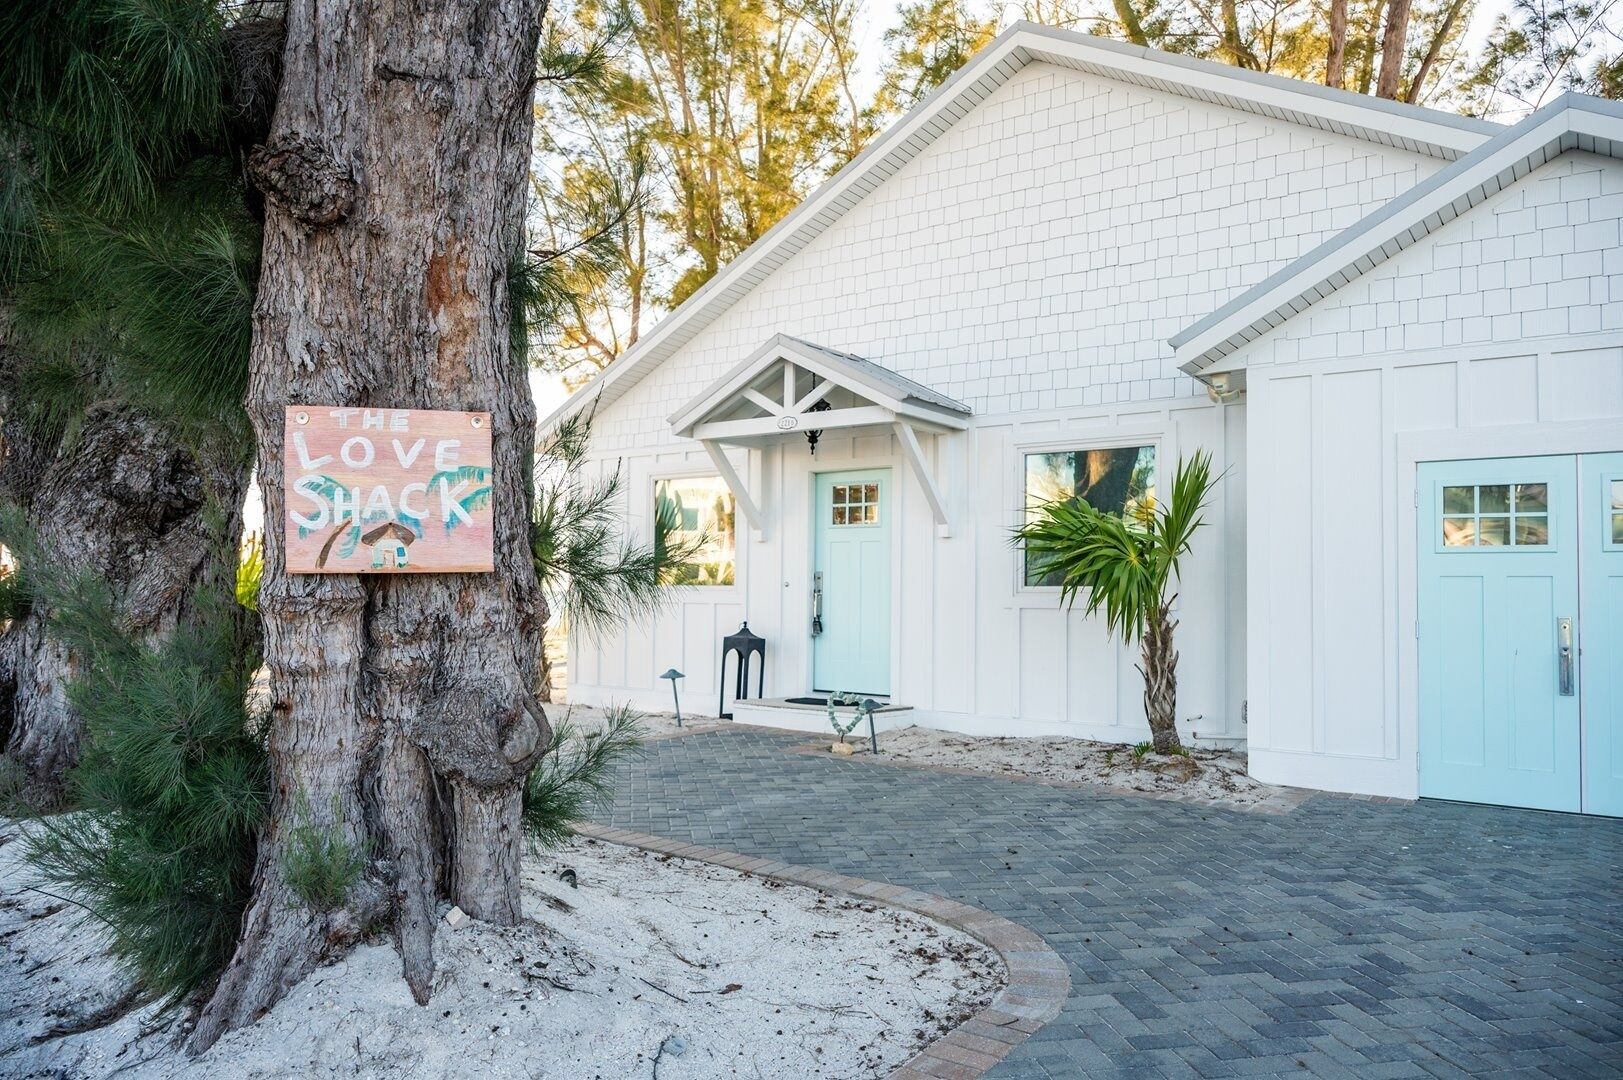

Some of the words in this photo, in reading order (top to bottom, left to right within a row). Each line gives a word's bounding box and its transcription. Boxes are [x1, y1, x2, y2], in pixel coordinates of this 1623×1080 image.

[330, 410, 411, 432] THE
[293, 431, 461, 471] LOVE
[290, 474, 474, 530] SHACK
